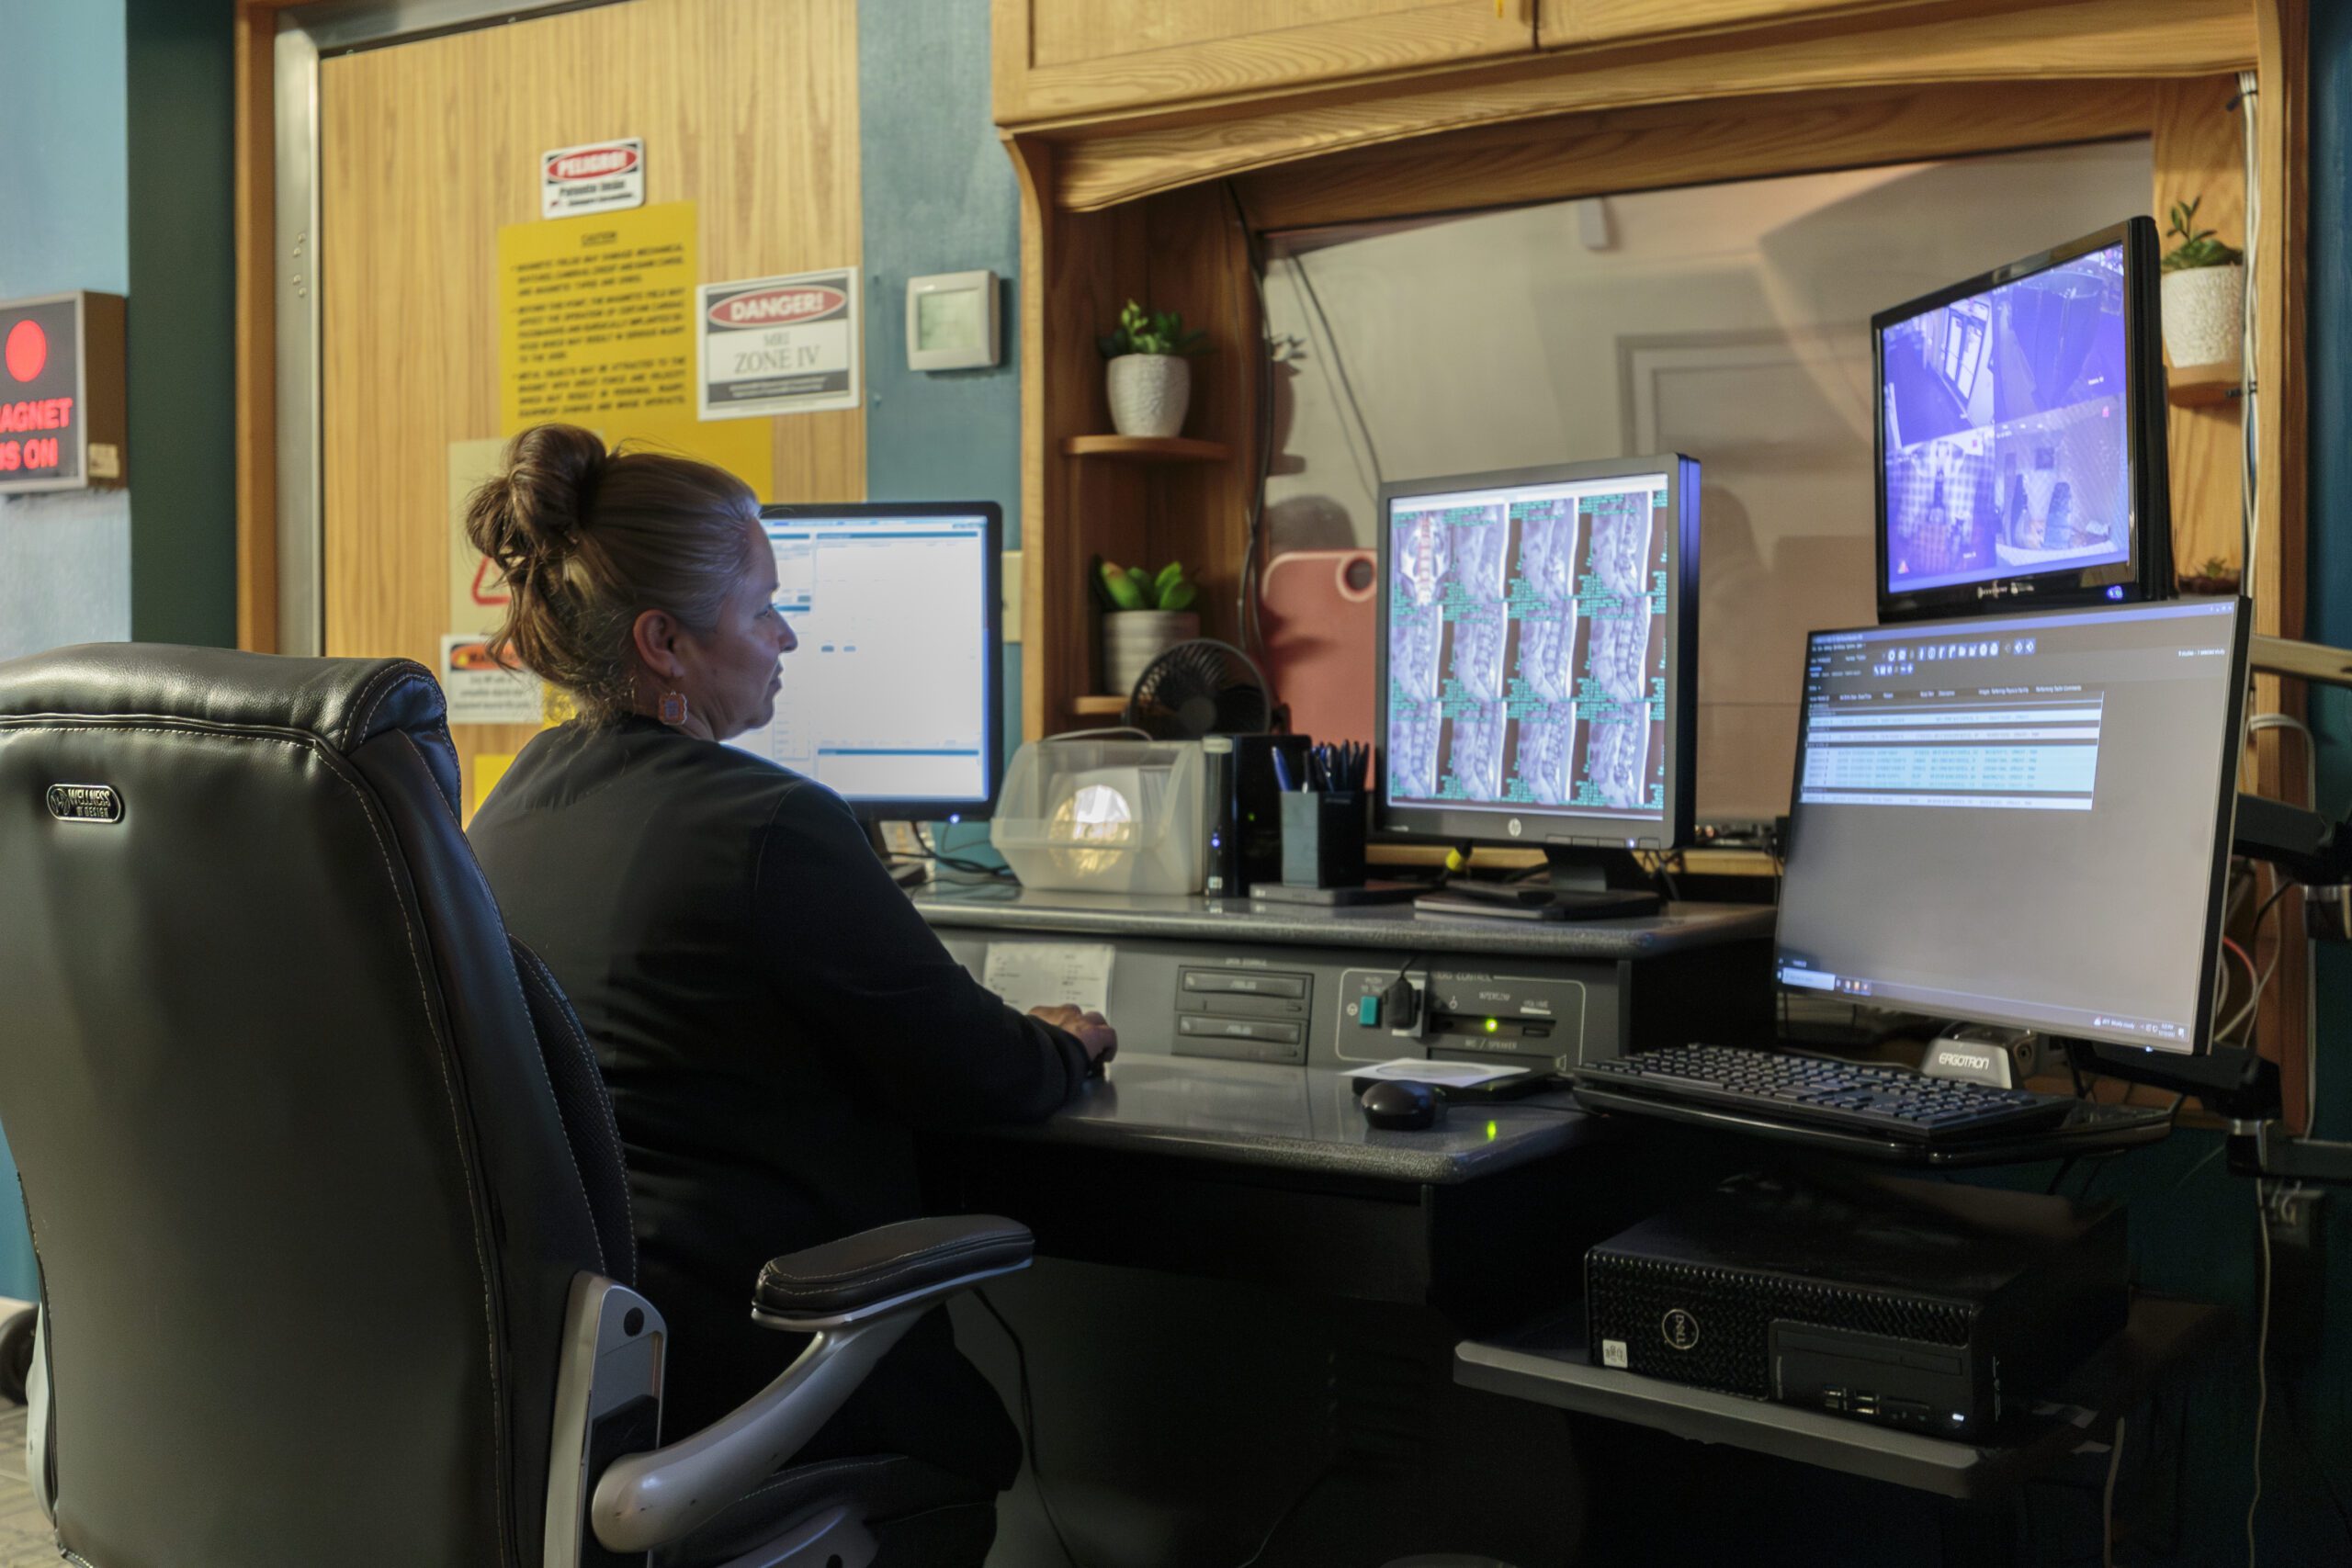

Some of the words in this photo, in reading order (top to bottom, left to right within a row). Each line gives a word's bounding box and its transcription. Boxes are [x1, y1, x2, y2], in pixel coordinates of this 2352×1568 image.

[729, 292, 824, 321] DANGER!
[734, 347, 792, 374] ZONE
[797, 344, 820, 368] IV
[0, 398, 73, 433] AGNET
[24, 437, 58, 469] ON
[68, 789, 111, 807] WELLNESS
[1939, 1052, 1990, 1070] ERGOTRON
